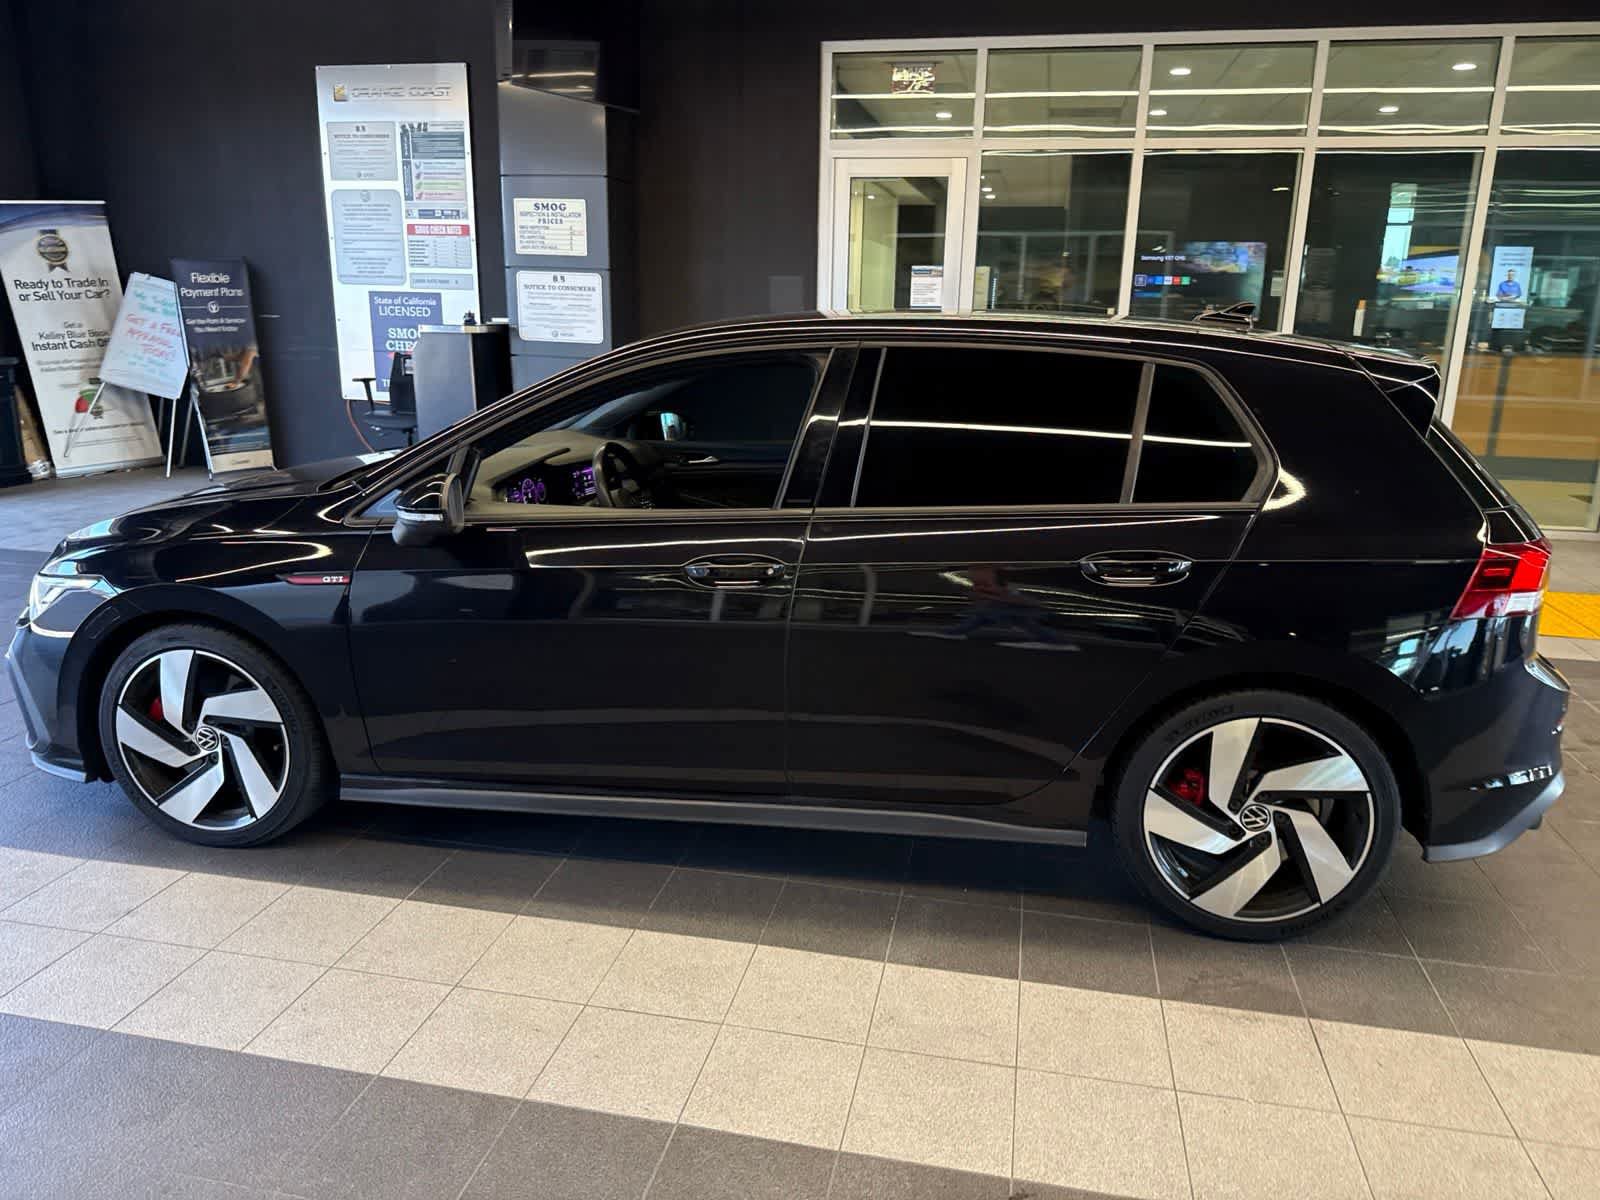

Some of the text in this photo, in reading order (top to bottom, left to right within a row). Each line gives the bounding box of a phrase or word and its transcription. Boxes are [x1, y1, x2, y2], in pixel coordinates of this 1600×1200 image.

[534, 202, 567, 212] SMOG
[14, 278, 109, 290] Ready to Trade In
[191, 272, 231, 284] Flexible
[19, 288, 110, 302] or Sell Your Car?
[180, 287, 243, 299] Payment Plans
[374, 296, 437, 306] State of California
[379, 306, 431, 317] LICENSED
[66, 330, 86, 339] Blue
[31, 341, 68, 352] Instant
[69, 339, 95, 349] Cash
